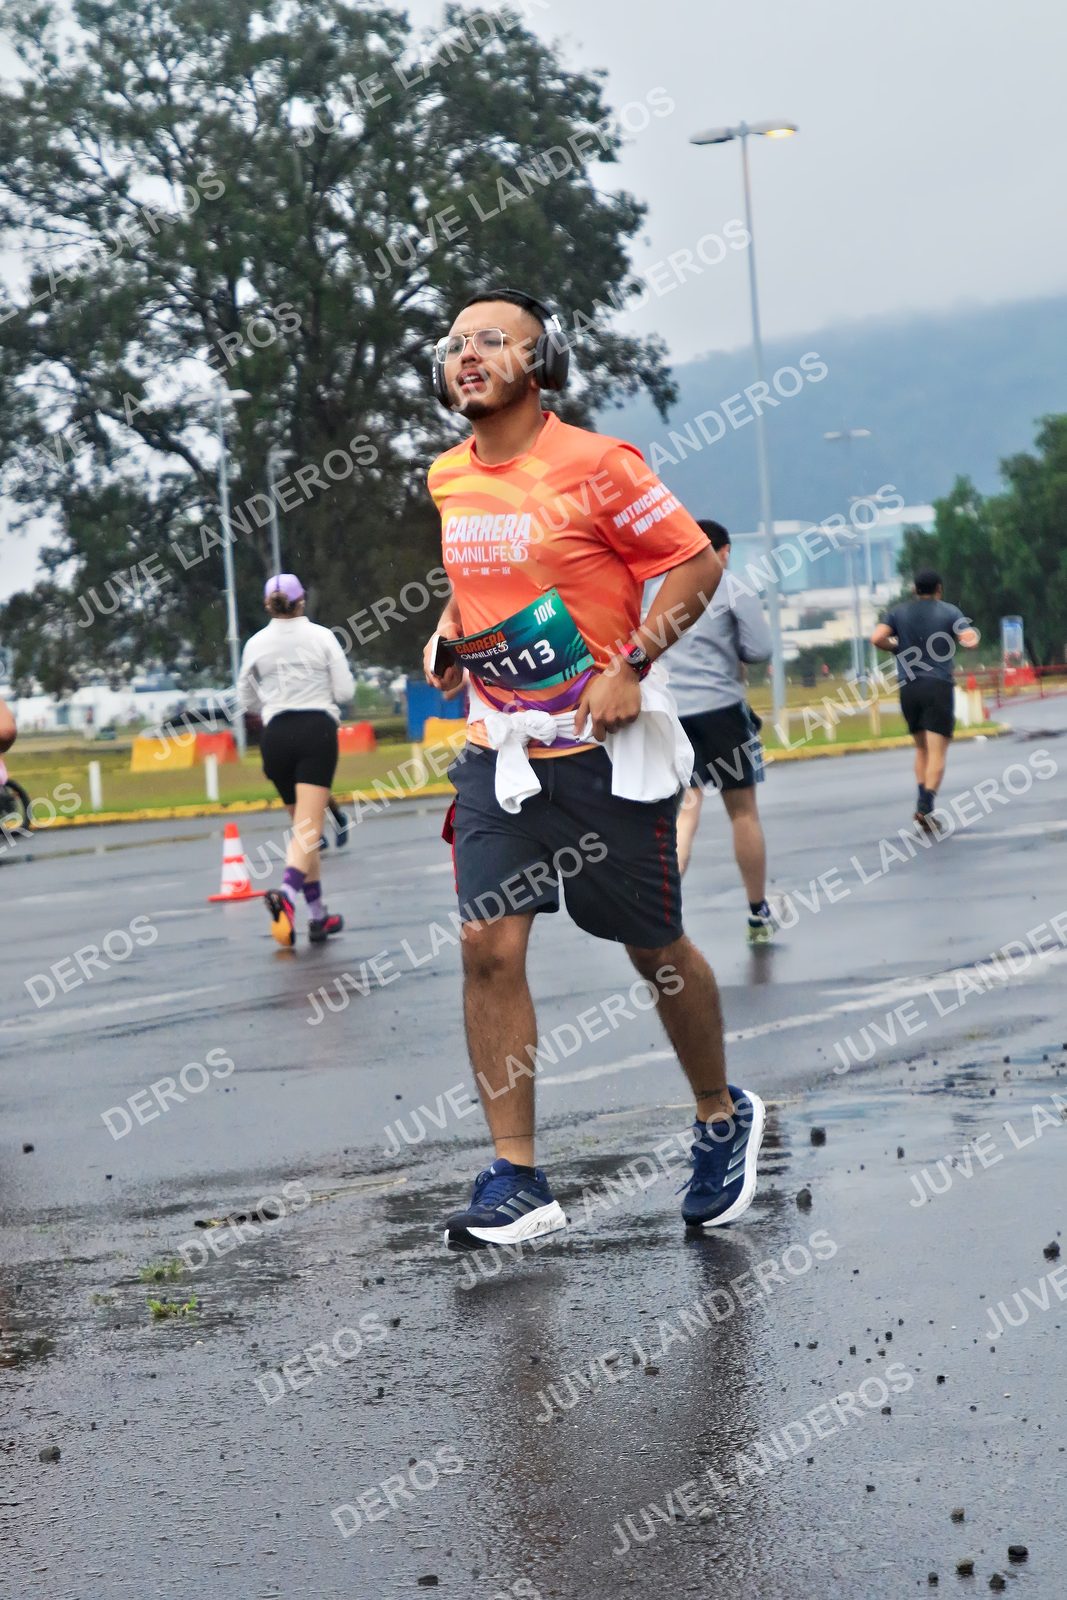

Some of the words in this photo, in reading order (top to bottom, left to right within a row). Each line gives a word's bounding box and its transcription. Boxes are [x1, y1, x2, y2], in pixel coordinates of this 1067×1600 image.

[446, 513, 530, 543] CARRERA
[533, 599, 557, 626] 10K
[455, 631, 506, 654] CARRERA
[483, 639, 556, 677] 1113
